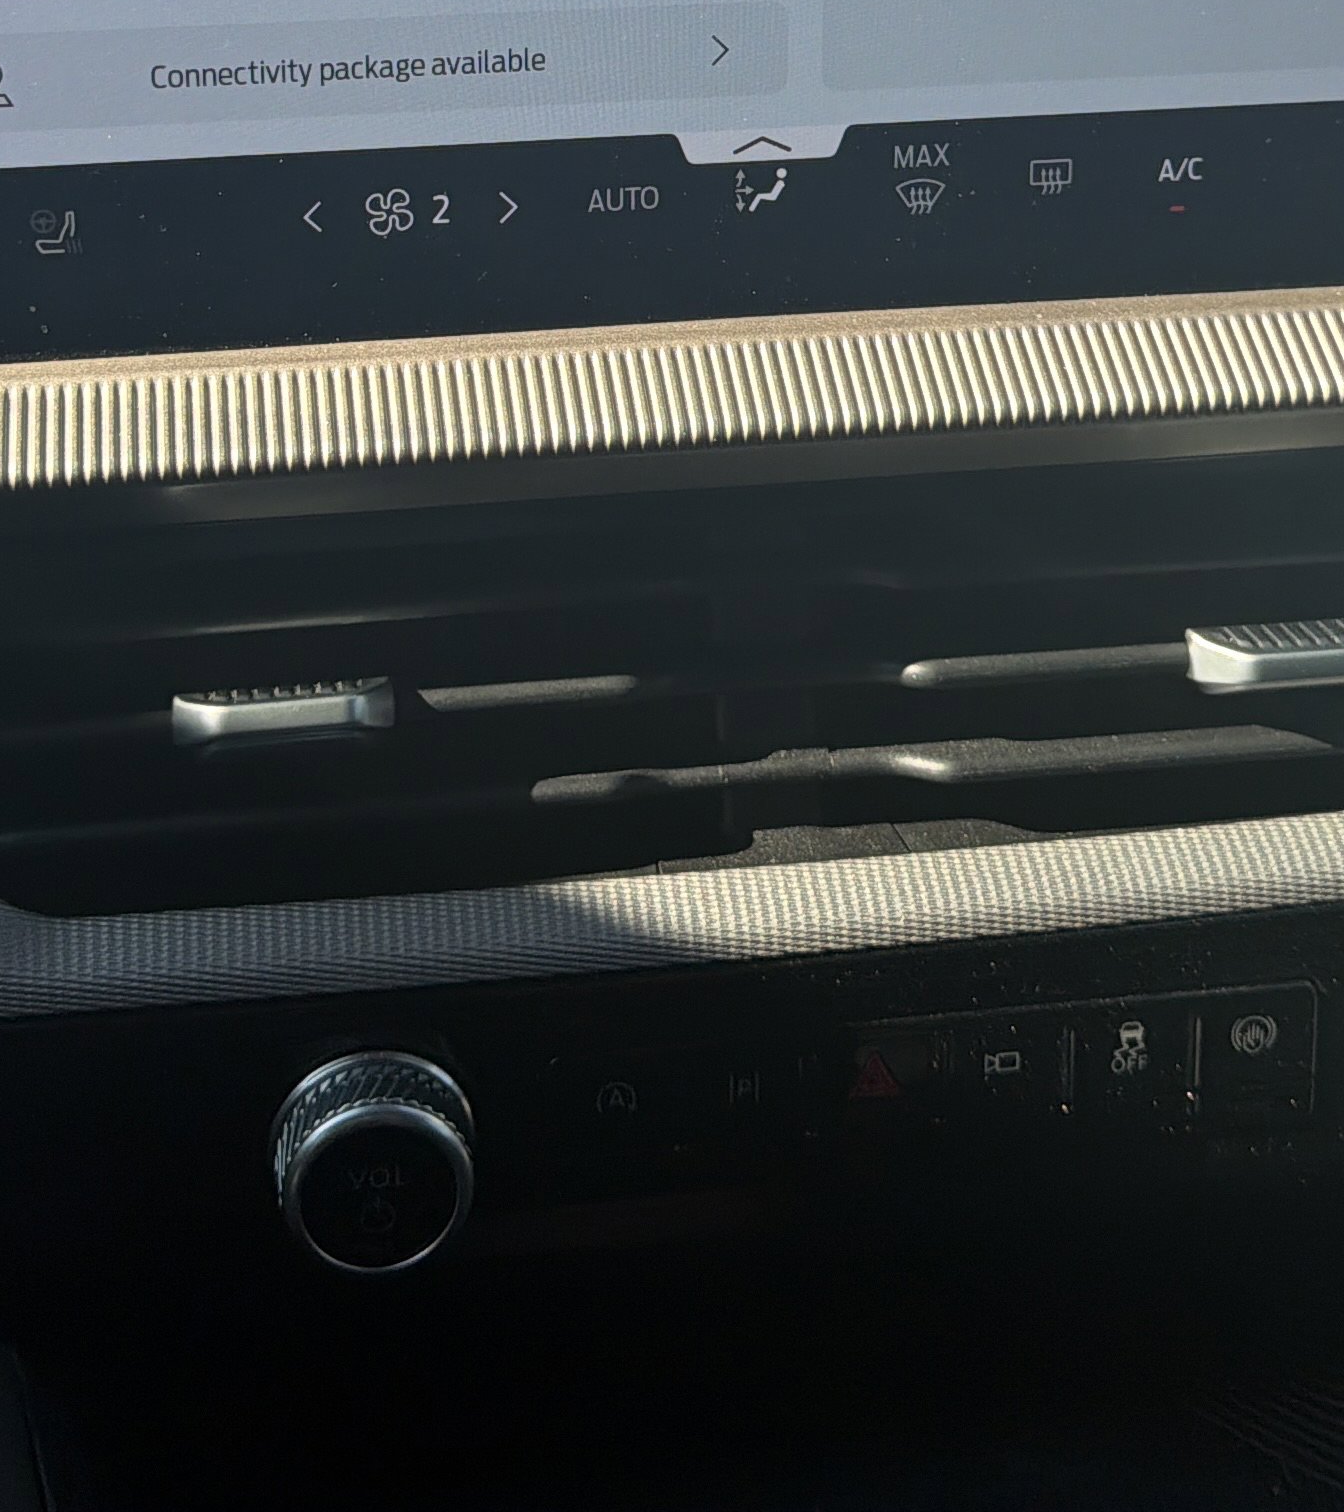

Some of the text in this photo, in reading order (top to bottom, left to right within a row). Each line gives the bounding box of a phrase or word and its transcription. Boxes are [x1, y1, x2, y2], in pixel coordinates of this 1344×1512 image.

[151, 47, 547, 89] Connectivity package available
[893, 142, 951, 169] MAX
[1159, 157, 1204, 183] A/C
[432, 194, 451, 225] 2
[588, 185, 660, 213] AUTO
[1111, 1054, 1148, 1074] OFF
